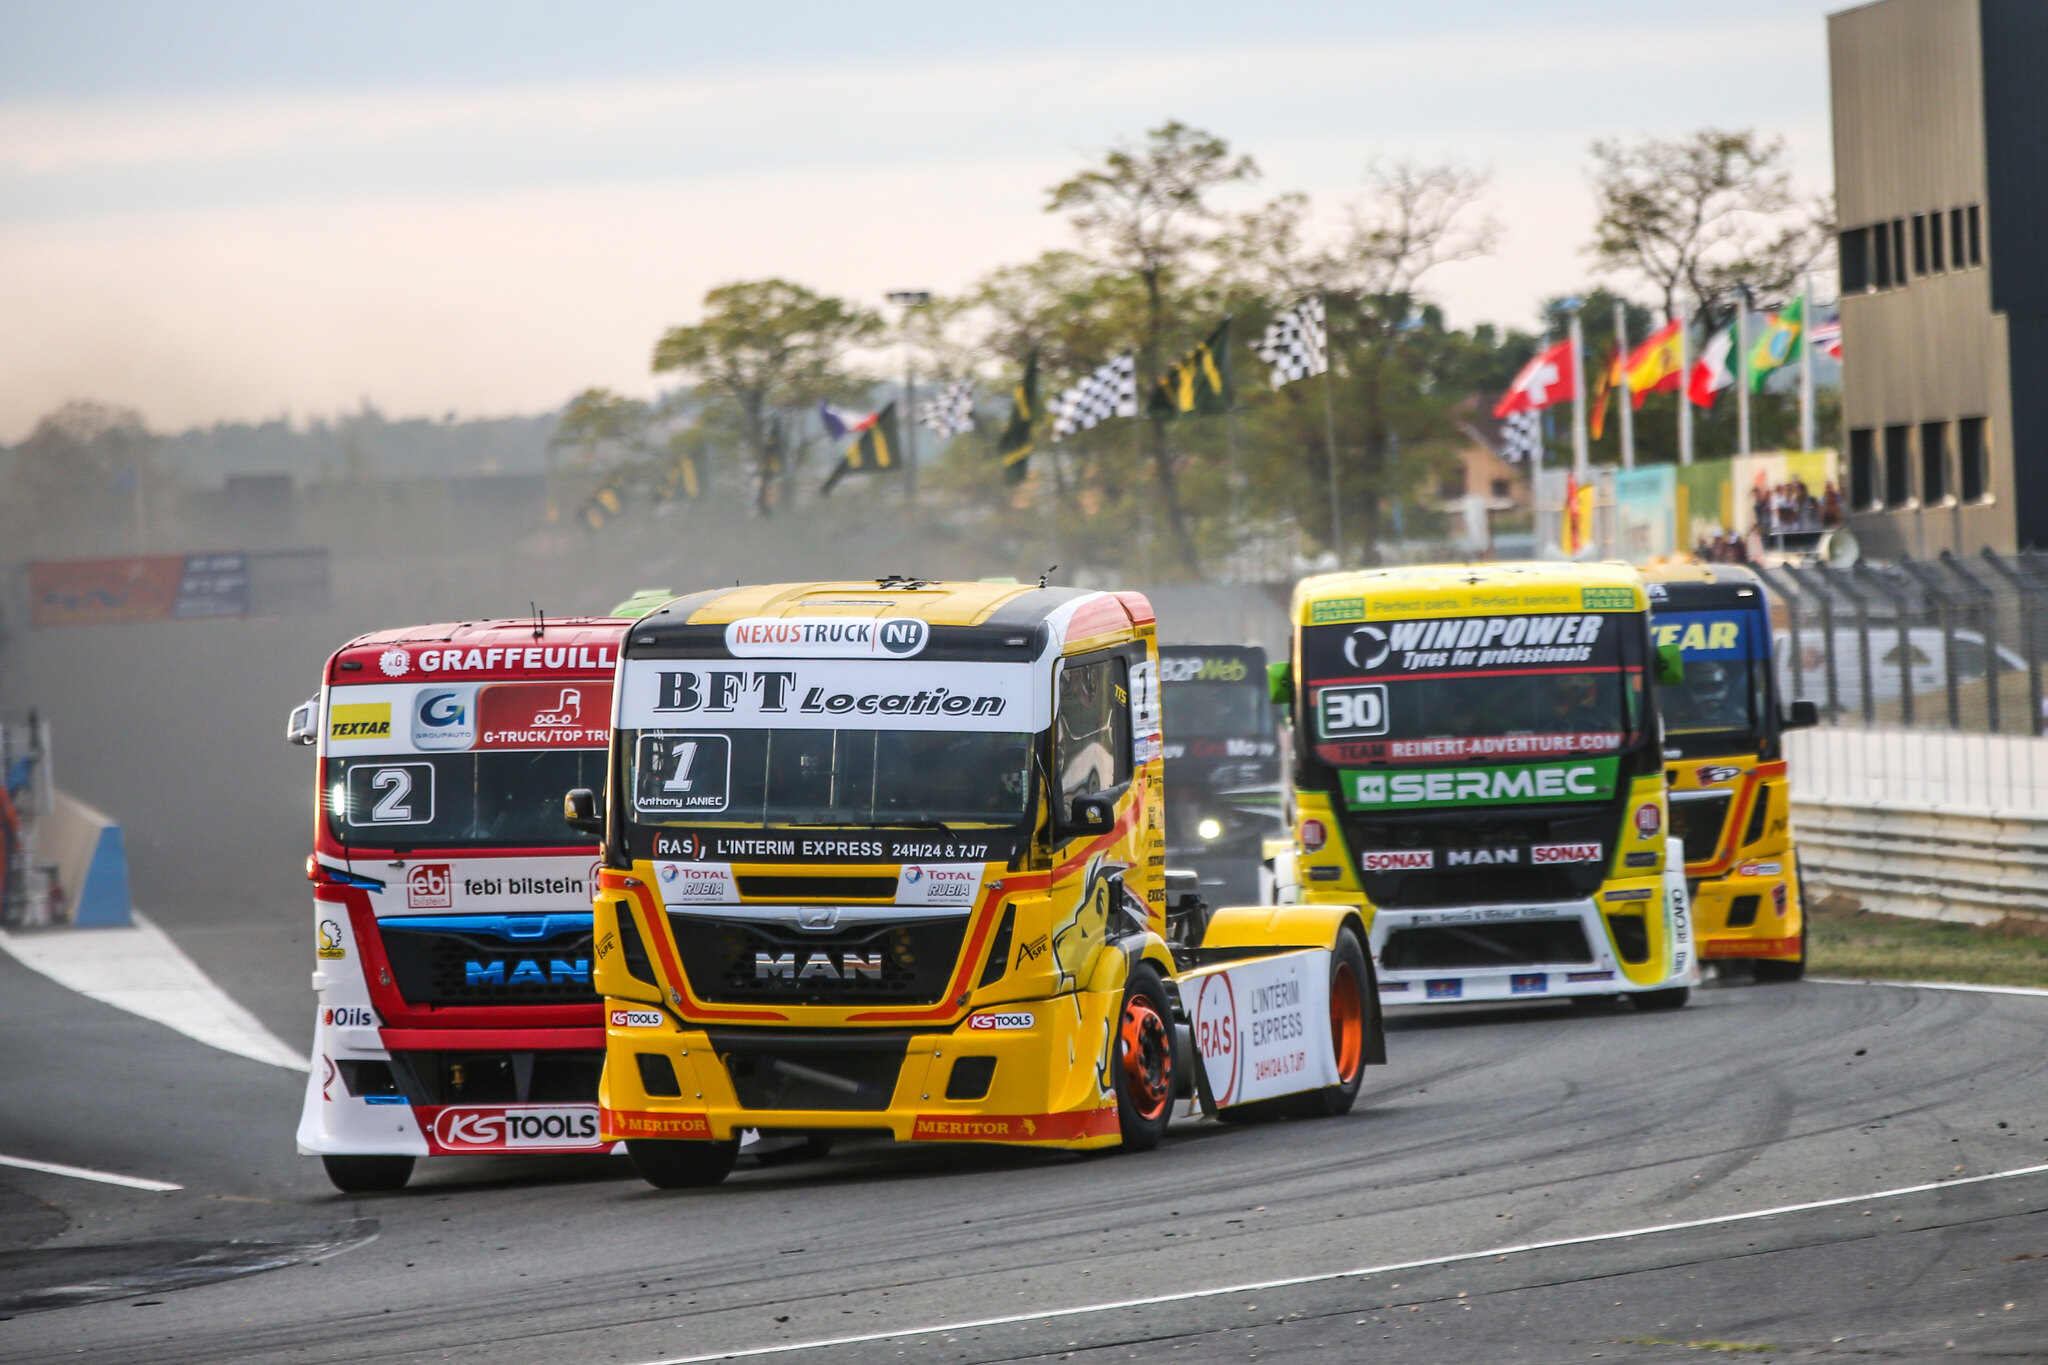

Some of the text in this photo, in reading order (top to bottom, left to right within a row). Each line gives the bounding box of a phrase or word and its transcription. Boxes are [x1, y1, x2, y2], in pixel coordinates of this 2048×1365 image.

[1374, 601, 1420, 612] Perfect
[735, 623, 870, 644] NEXUSTRUCK
[1390, 615, 1604, 651] WINDPOWER
[1650, 621, 1739, 651] EAR
[1403, 645, 1592, 670] Tyres for professionals
[653, 671, 1006, 715] BFT Location
[1326, 694, 1381, 729] 30
[331, 721, 390, 736] TEXTAR
[1340, 735, 1620, 760] TEAM REINERT-ADVENTURE.COM
[662, 741, 698, 792] 1
[372, 768, 412, 821] 2
[1391, 767, 1596, 802] SERMEC
[638, 796, 722, 809] Anthony JANIEC
[802, 841, 882, 857] EXPRESS
[892, 844, 941, 858] 24H/24
[945, 845, 955, 857] &
[959, 845, 988, 858] 7J/7
[1364, 845, 1600, 869] SONAX MAN SONAX
[408, 866, 583, 895] febi febi bilstein
[682, 869, 728, 879] TOTAL
[927, 870, 975, 880] TOTAL
[413, 896, 446, 906] bilstein
[683, 883, 723, 895] RUBIA
[928, 884, 969, 896] RUBIA
[466, 960, 589, 985] MAN
[756, 953, 882, 979] MAN
[335, 1008, 371, 1026] Oils
[1253, 1012, 1303, 1046] EXPRESS
[1201, 1016, 1231, 1059] RAS
[629, 1118, 706, 1132] MERITOR
[917, 1120, 1009, 1134] MERITOR
